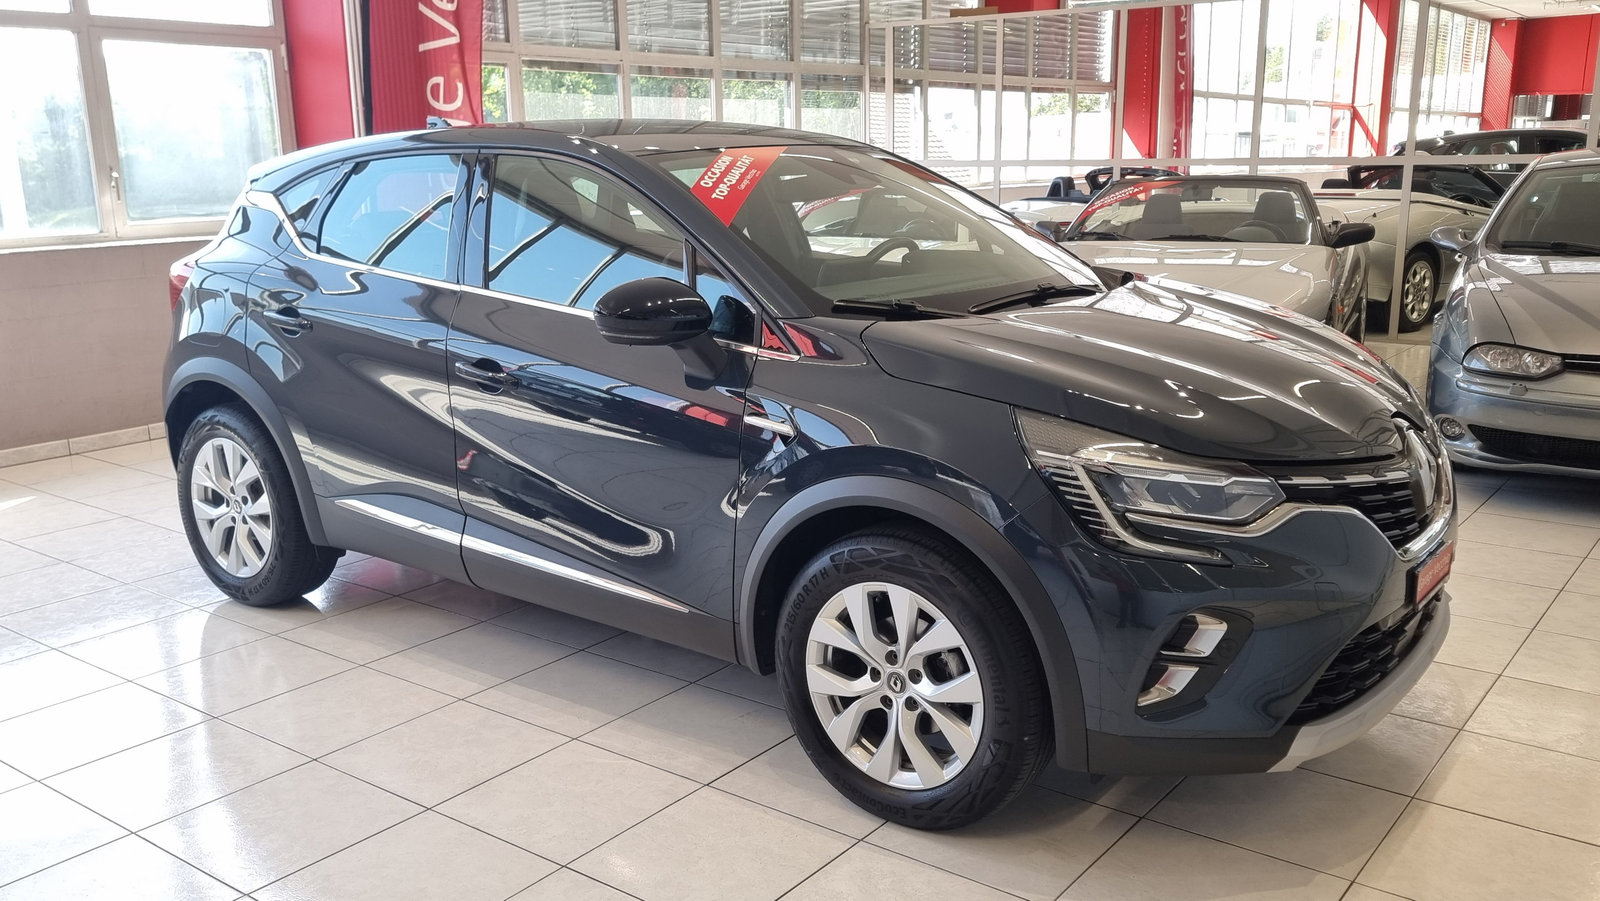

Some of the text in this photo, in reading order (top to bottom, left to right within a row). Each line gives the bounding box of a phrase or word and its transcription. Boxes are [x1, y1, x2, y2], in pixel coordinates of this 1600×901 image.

[700, 155, 734, 188] OCCASION
[711, 154, 755, 200] TOP-QUALITÄT
[1094, 186, 1135, 205] OCCASION
[784, 566, 829, 632] 215/60 R 17 H
